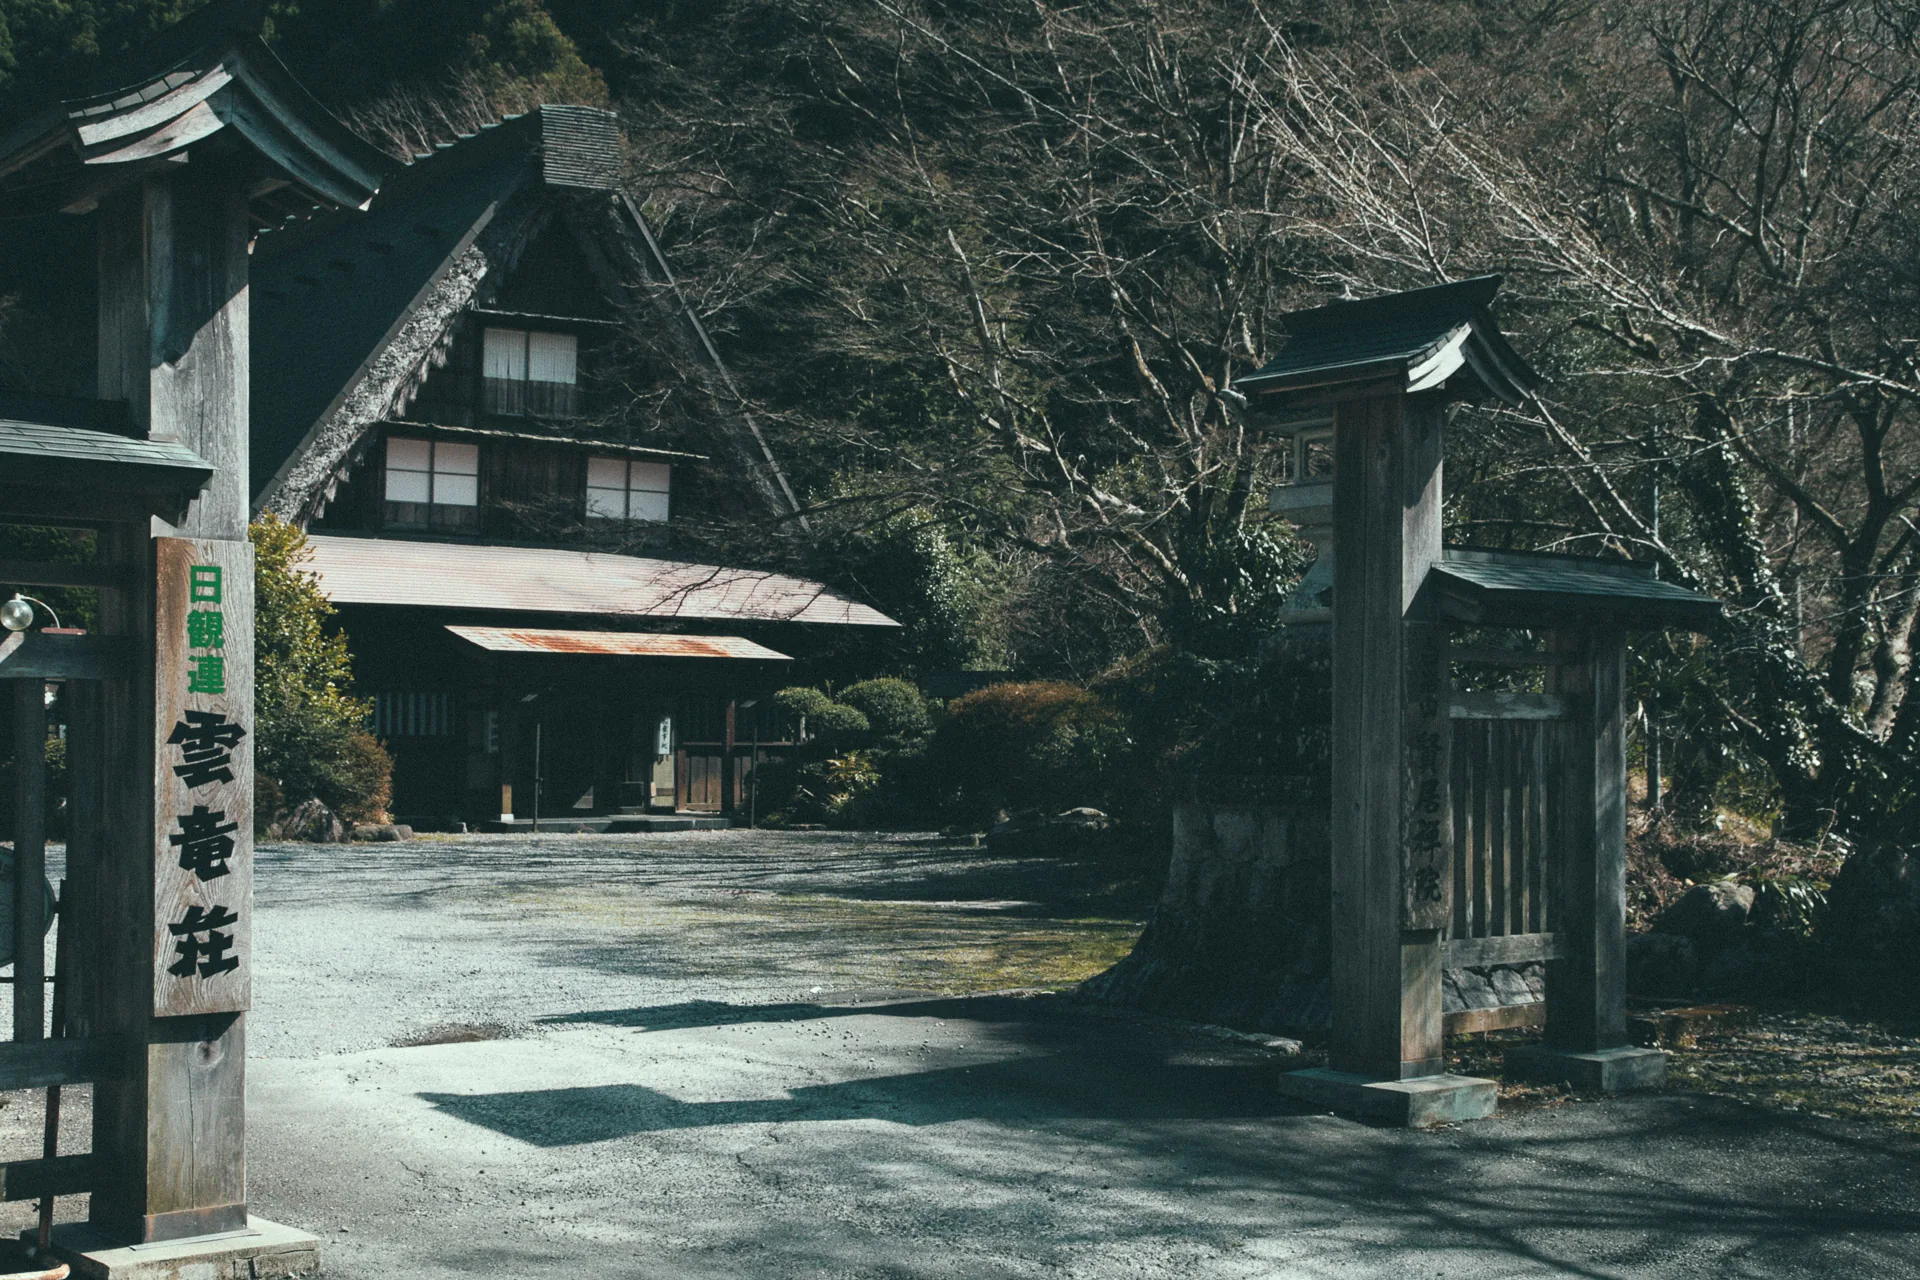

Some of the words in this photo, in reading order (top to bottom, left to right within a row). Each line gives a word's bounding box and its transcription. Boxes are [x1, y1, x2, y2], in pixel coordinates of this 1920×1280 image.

[187, 565, 226, 695] 日観連
[166, 708, 247, 980] 雲竜荘
